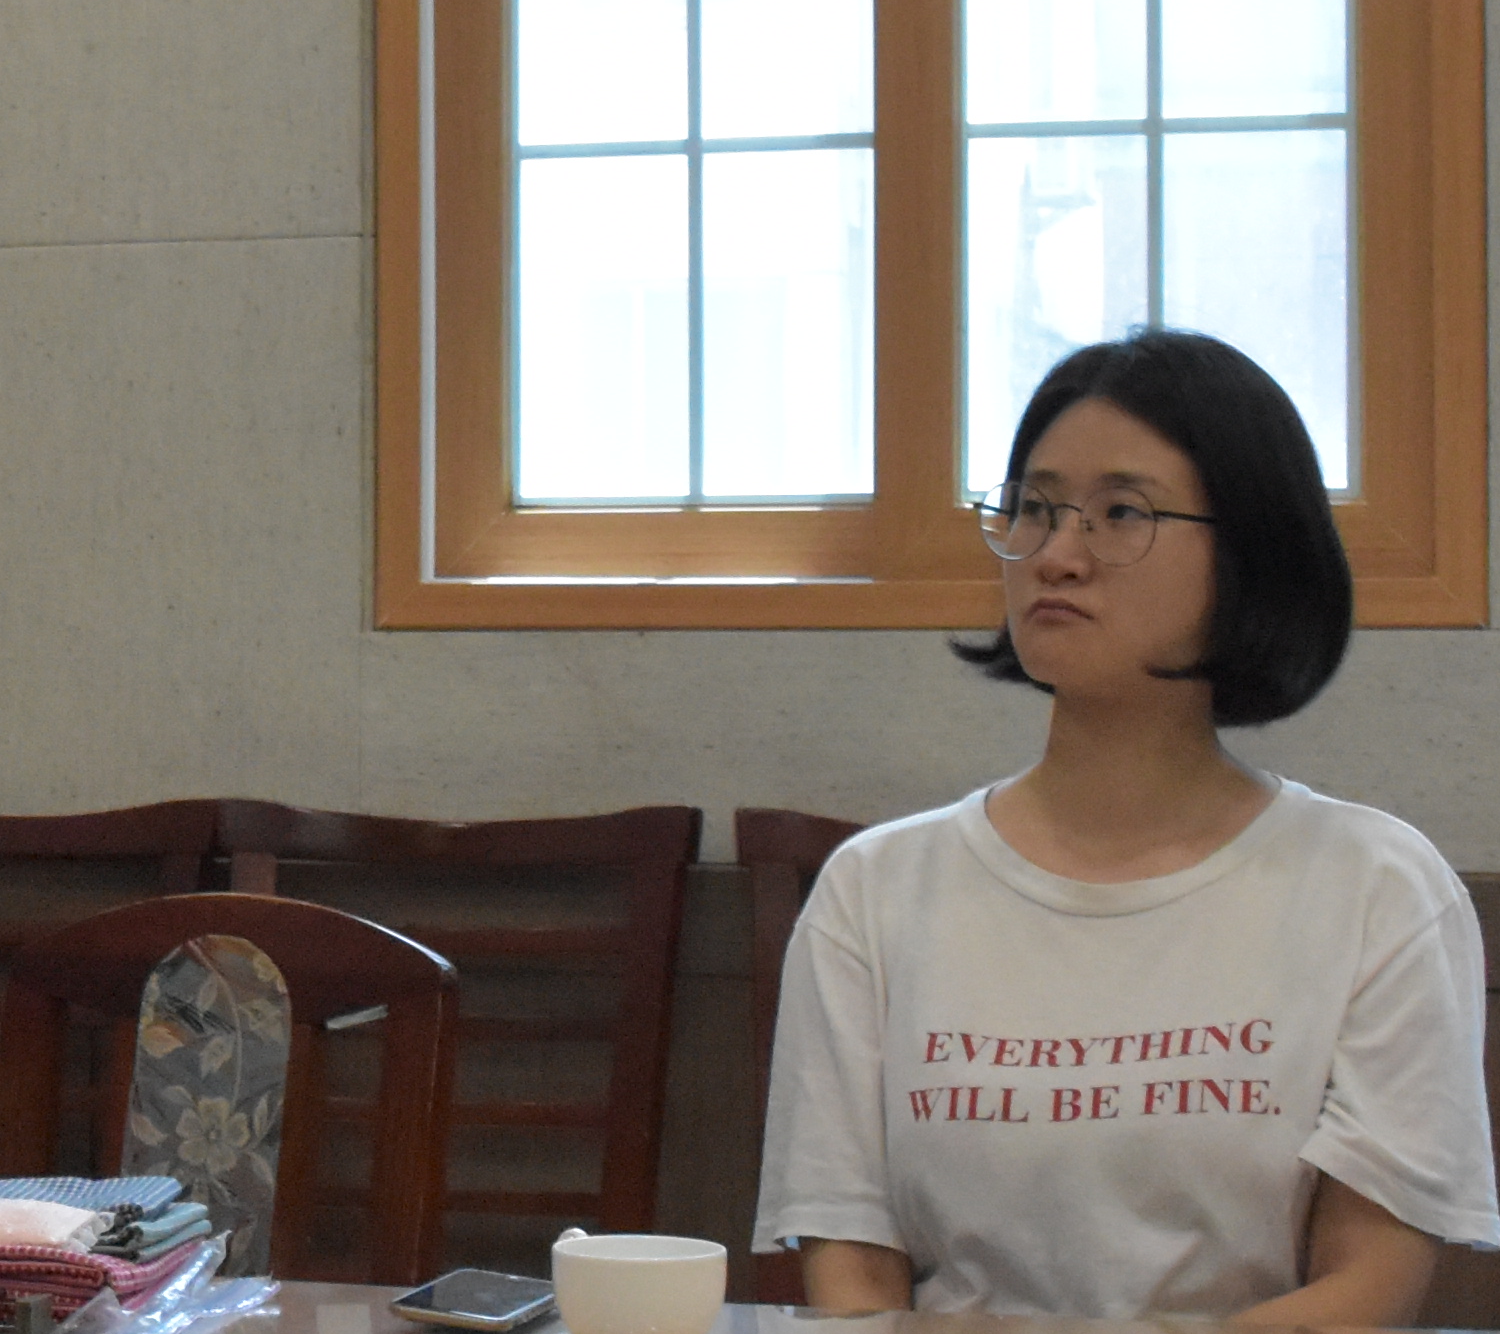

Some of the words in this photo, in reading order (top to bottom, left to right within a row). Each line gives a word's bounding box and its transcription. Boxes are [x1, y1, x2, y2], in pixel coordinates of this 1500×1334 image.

[923, 1018, 1275, 1068] EVERYTHING
[908, 1085, 1029, 1123] WILL
[1048, 1085, 1121, 1123] BE
[1140, 1078, 1282, 1116] FINE.
